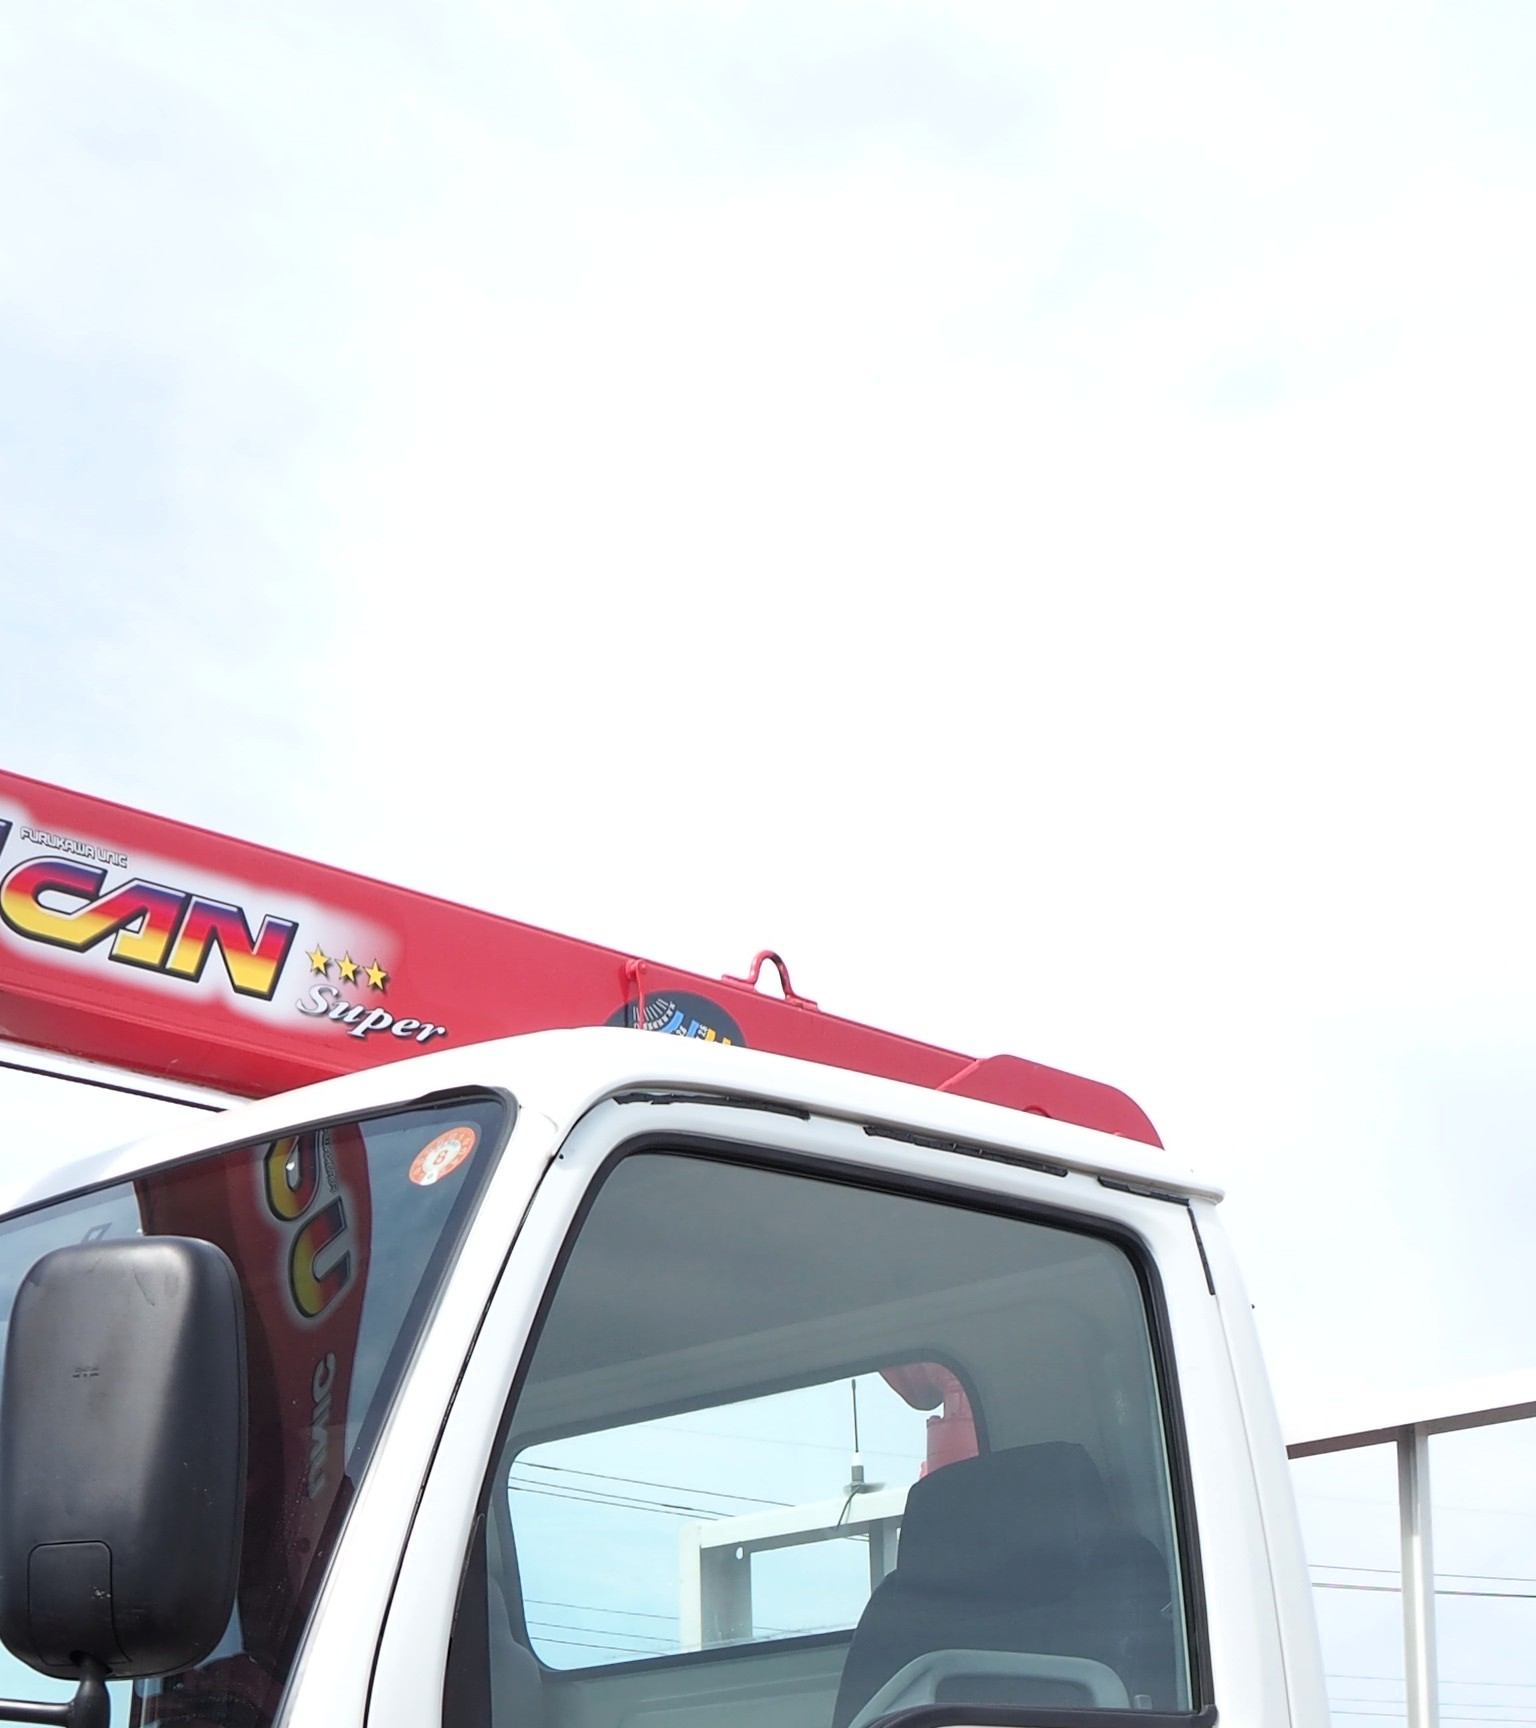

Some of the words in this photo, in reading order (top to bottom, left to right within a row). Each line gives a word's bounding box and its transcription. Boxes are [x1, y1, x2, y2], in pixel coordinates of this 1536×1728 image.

[19, 825, 96, 860] FURUKAWA
[96, 846, 129, 869] UNIC
[295, 983, 448, 1043] Super
